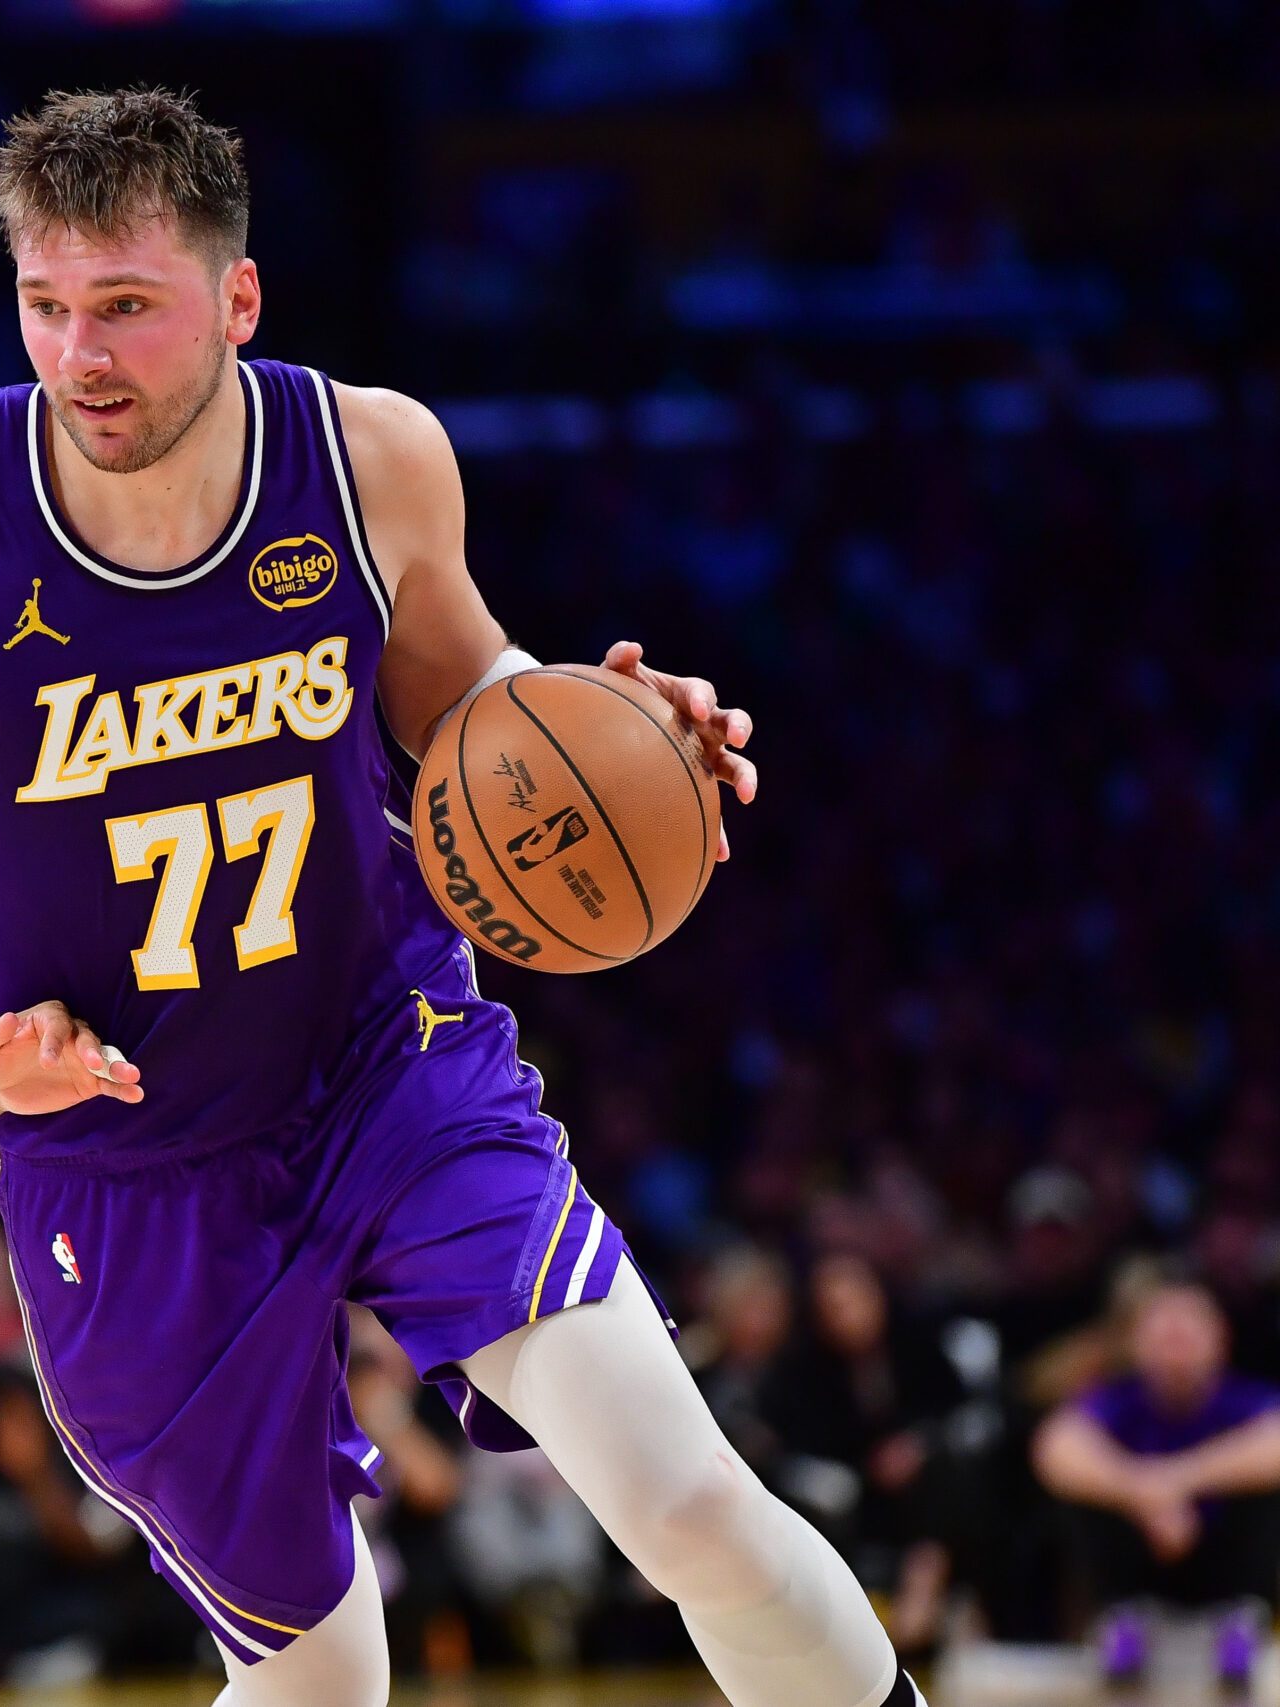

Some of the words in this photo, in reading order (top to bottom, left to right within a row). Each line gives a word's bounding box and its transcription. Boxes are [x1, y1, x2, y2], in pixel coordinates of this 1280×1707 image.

[256, 554, 332, 587] bibigo
[15, 636, 354, 803] LAKERS
[105, 775, 316, 991] 77
